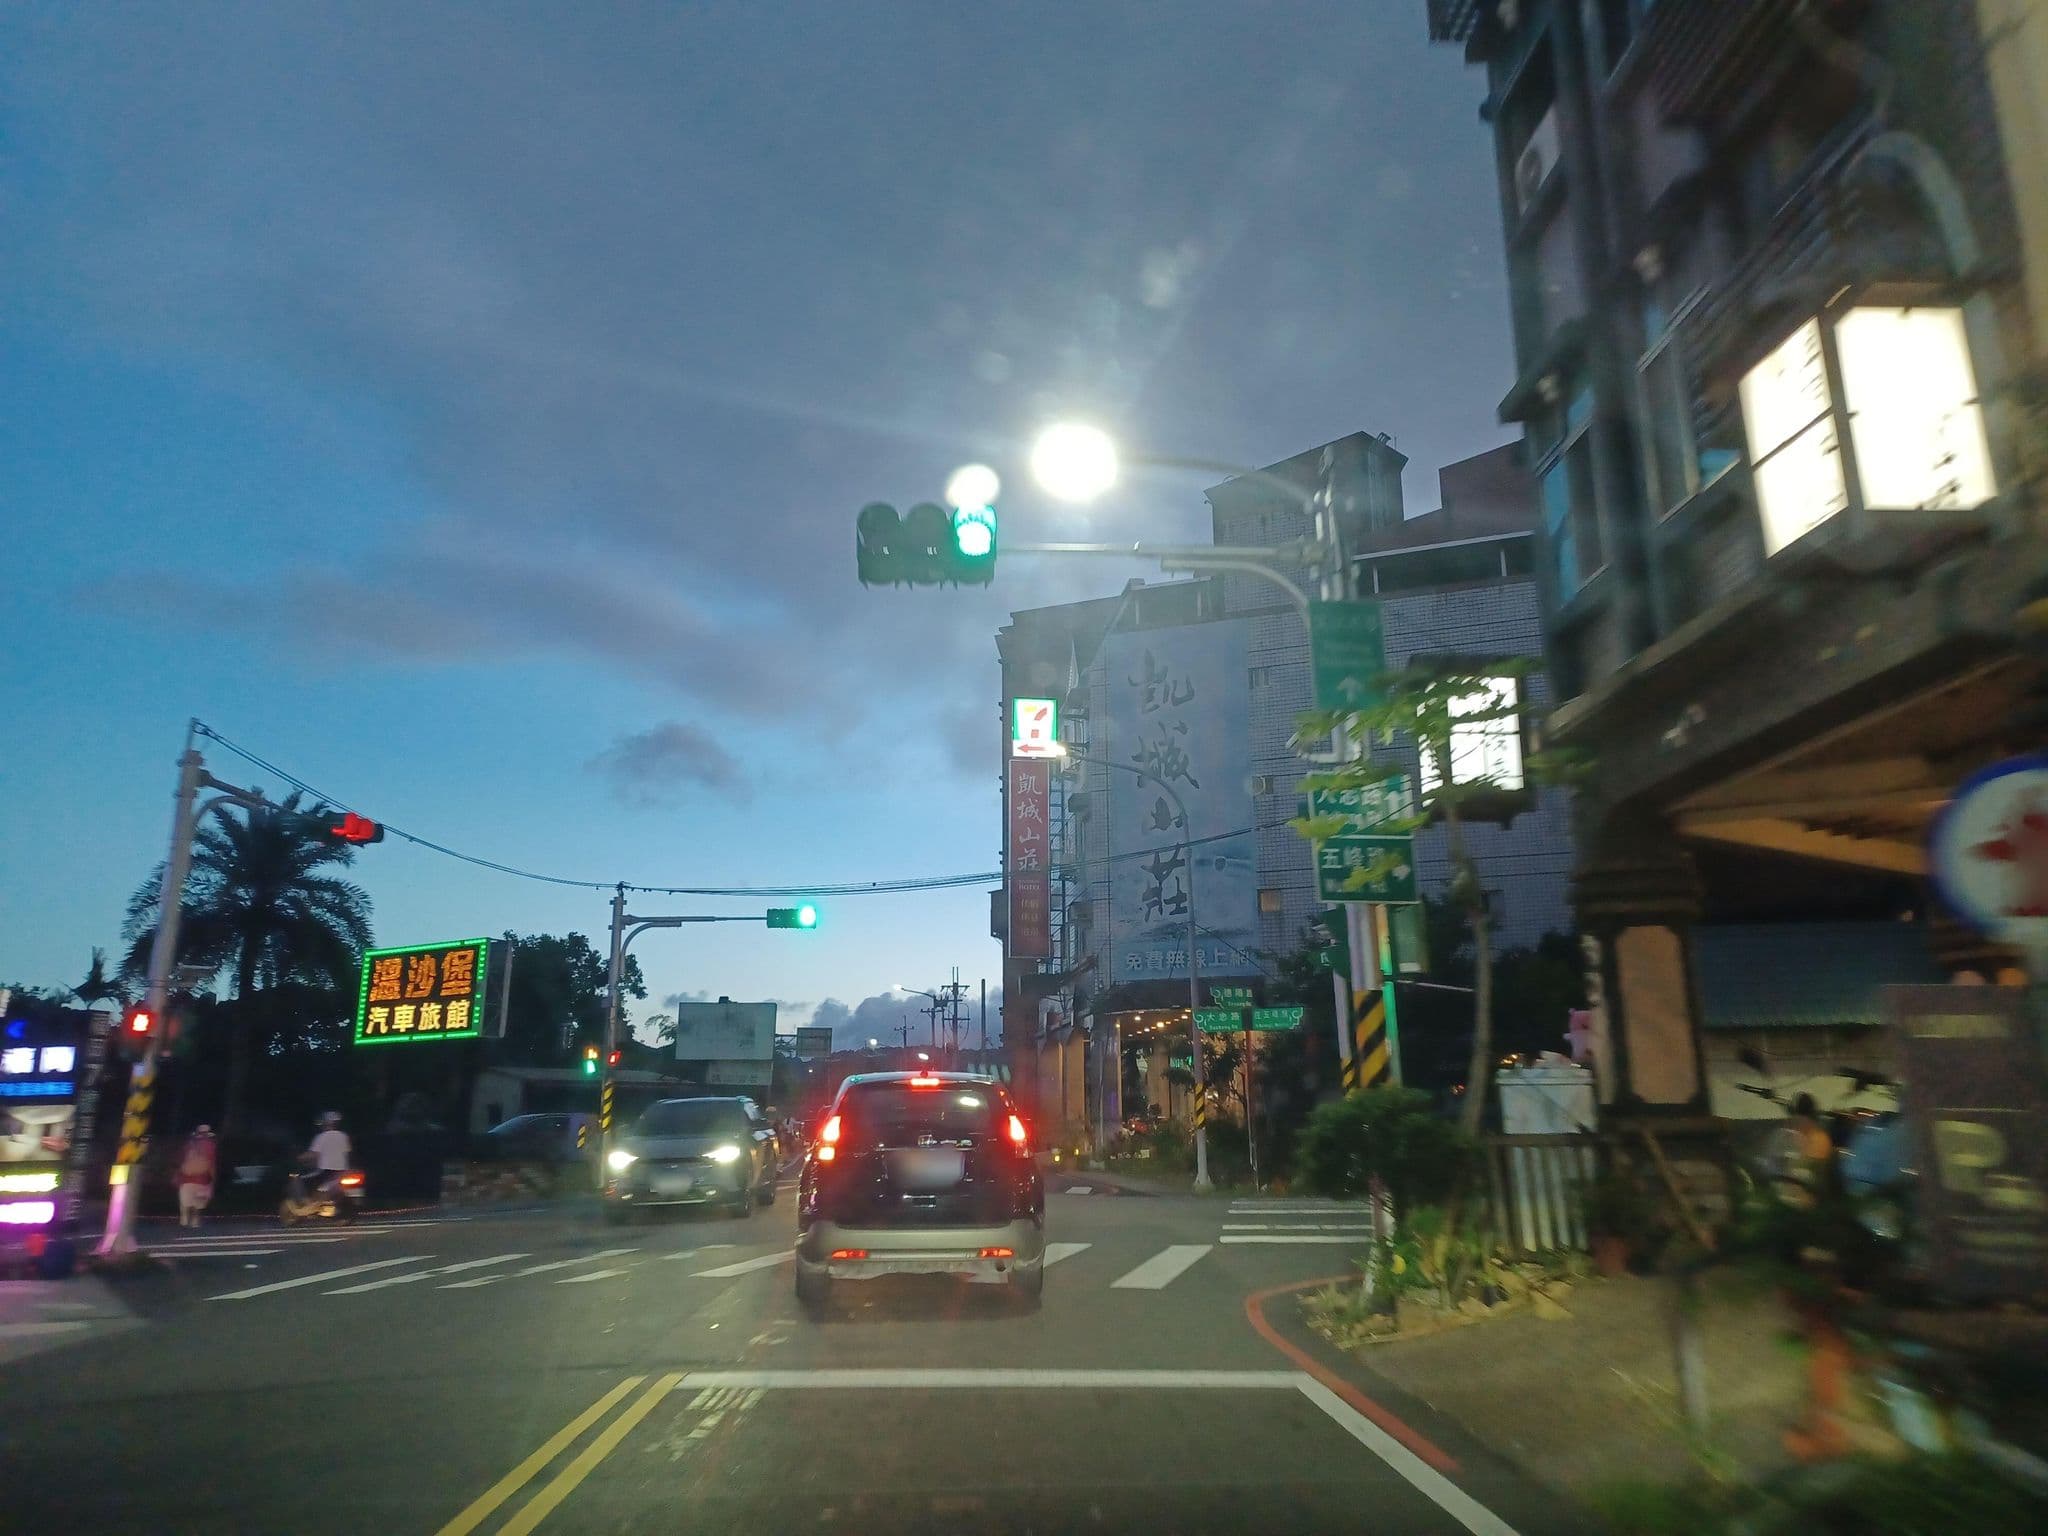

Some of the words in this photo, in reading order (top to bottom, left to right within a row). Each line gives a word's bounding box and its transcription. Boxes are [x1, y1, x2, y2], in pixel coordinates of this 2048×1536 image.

[1016, 773, 1042, 872] 凱城山莊
[366, 1000, 471, 1034] 汽車旅館
